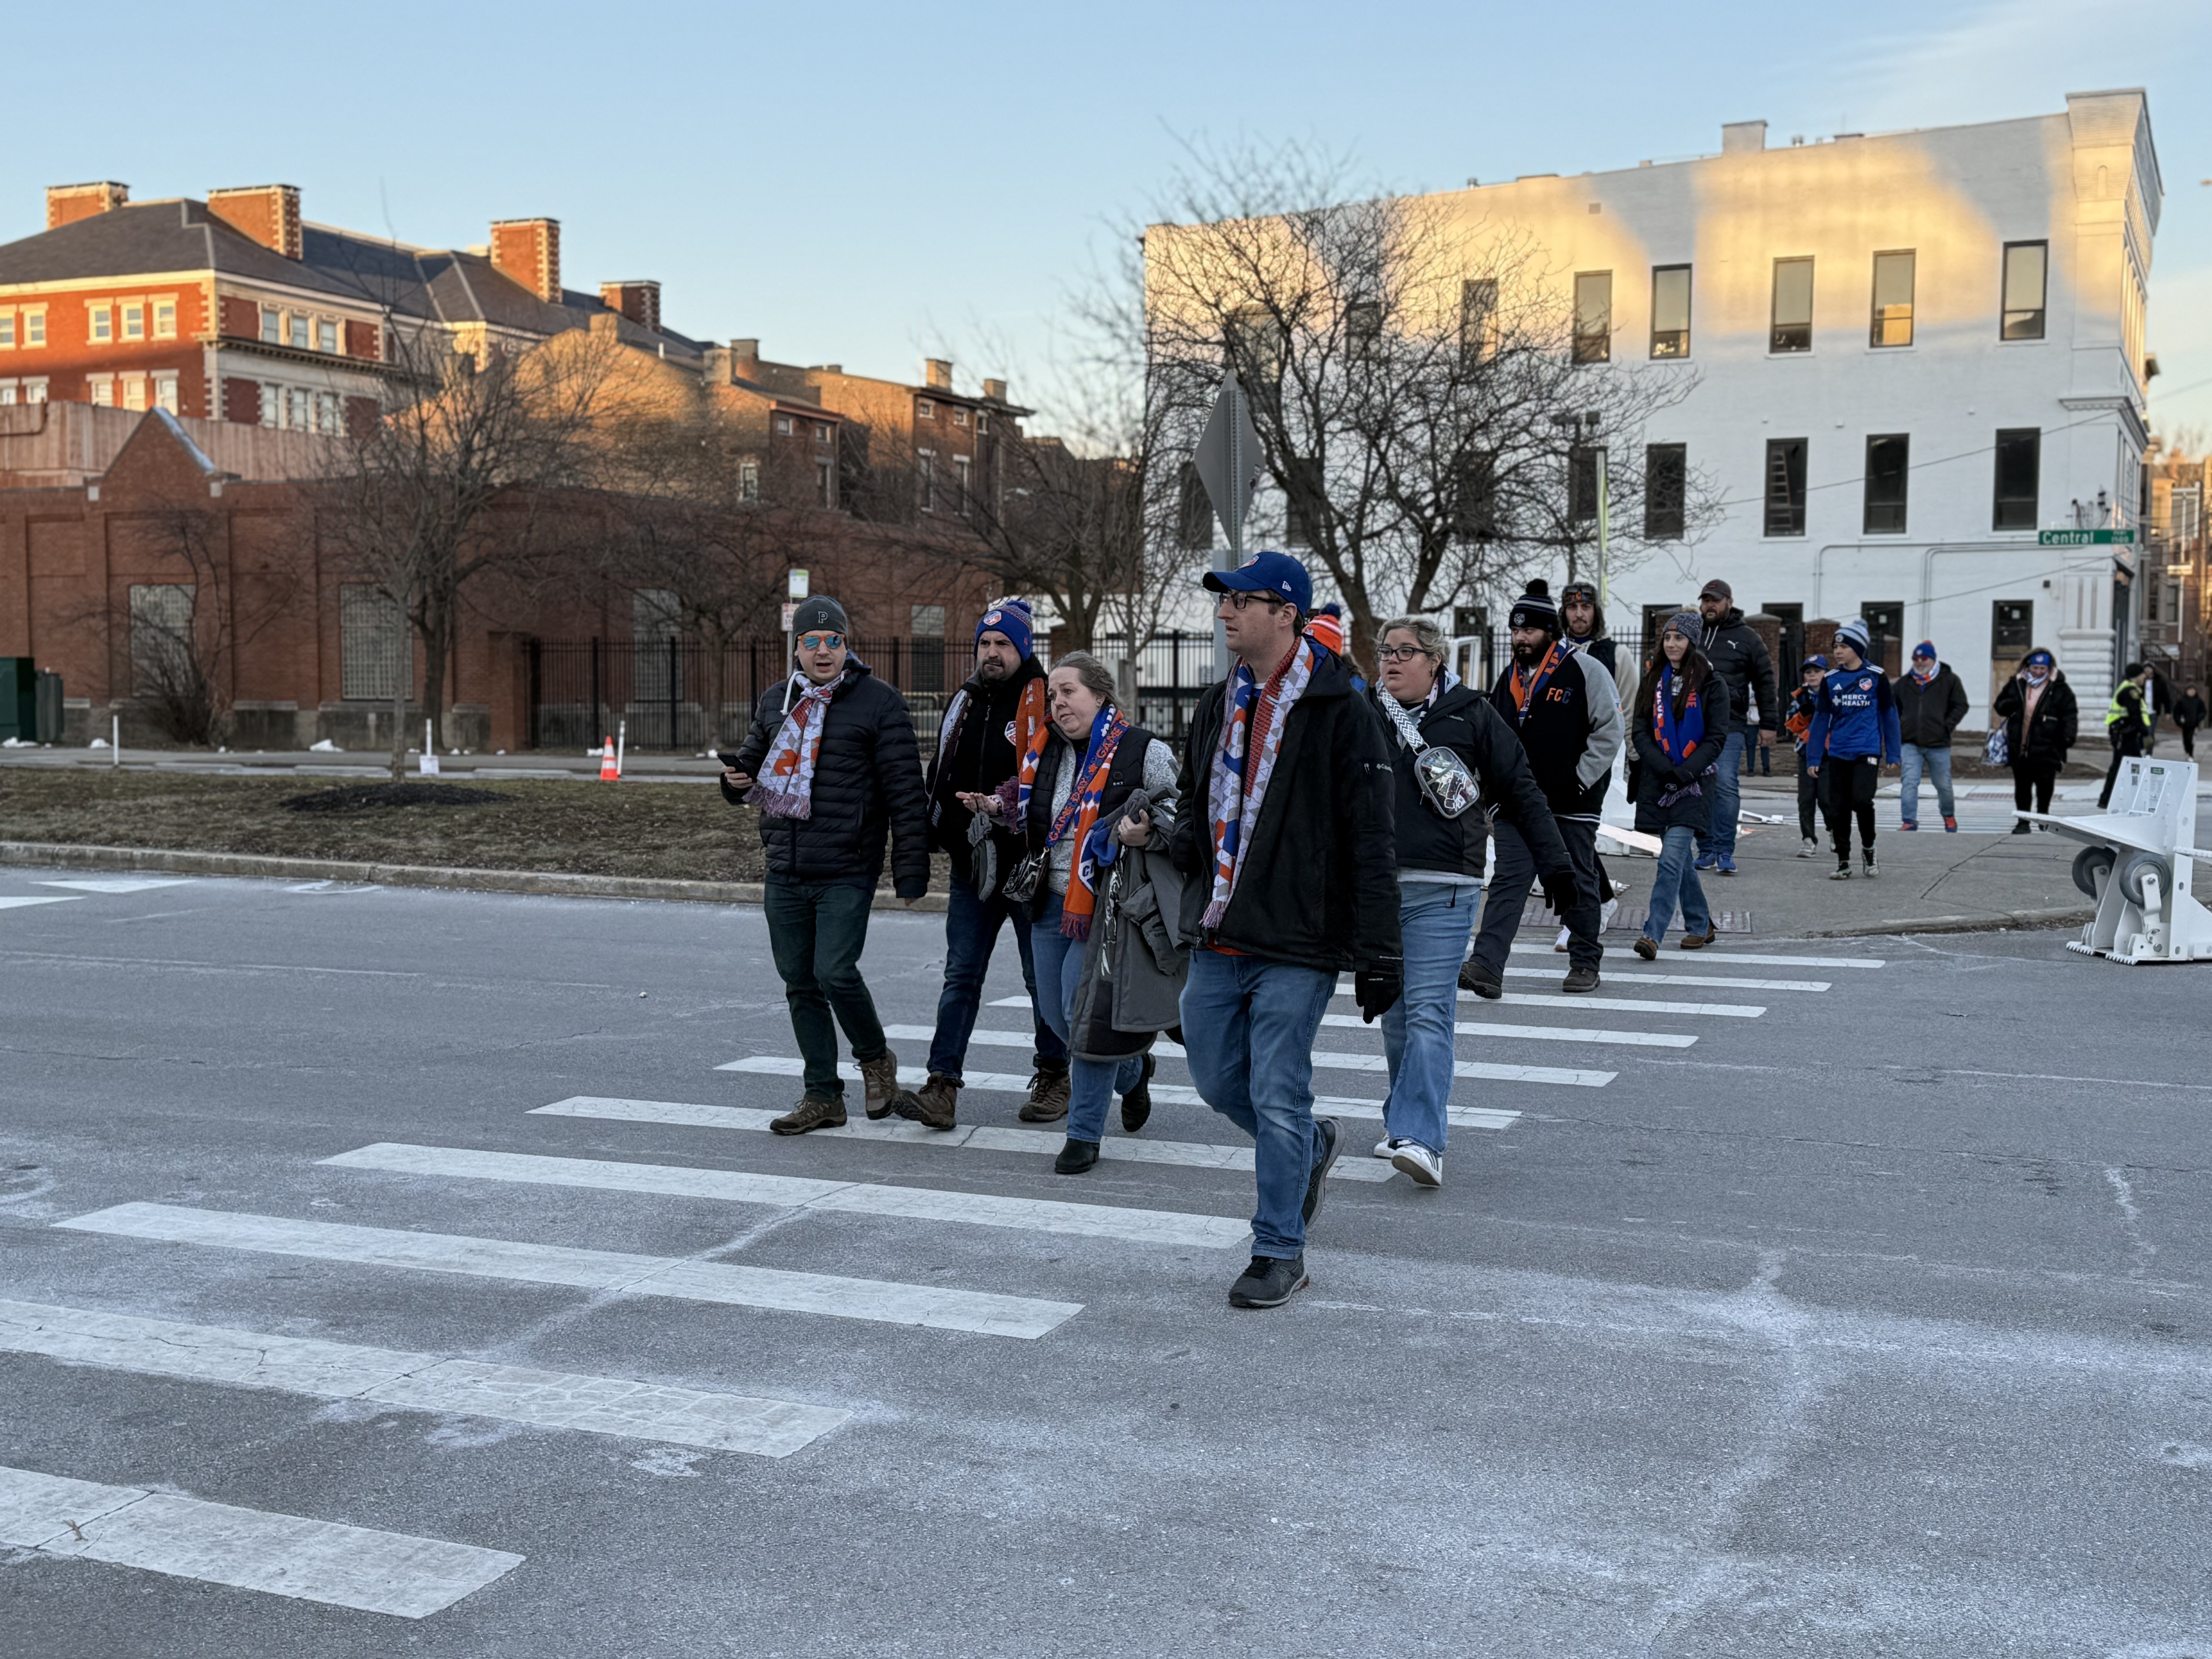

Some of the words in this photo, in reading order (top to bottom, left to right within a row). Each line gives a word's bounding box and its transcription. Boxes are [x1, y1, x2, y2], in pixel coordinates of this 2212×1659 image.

[2043, 532, 2094, 543] Central
[818, 611, 828, 623] P
[1546, 687, 1571, 704] FCC
[1049, 805, 1075, 841] GAME
[1070, 778, 1089, 802] DAY
[1096, 726, 1123, 759] GAME
